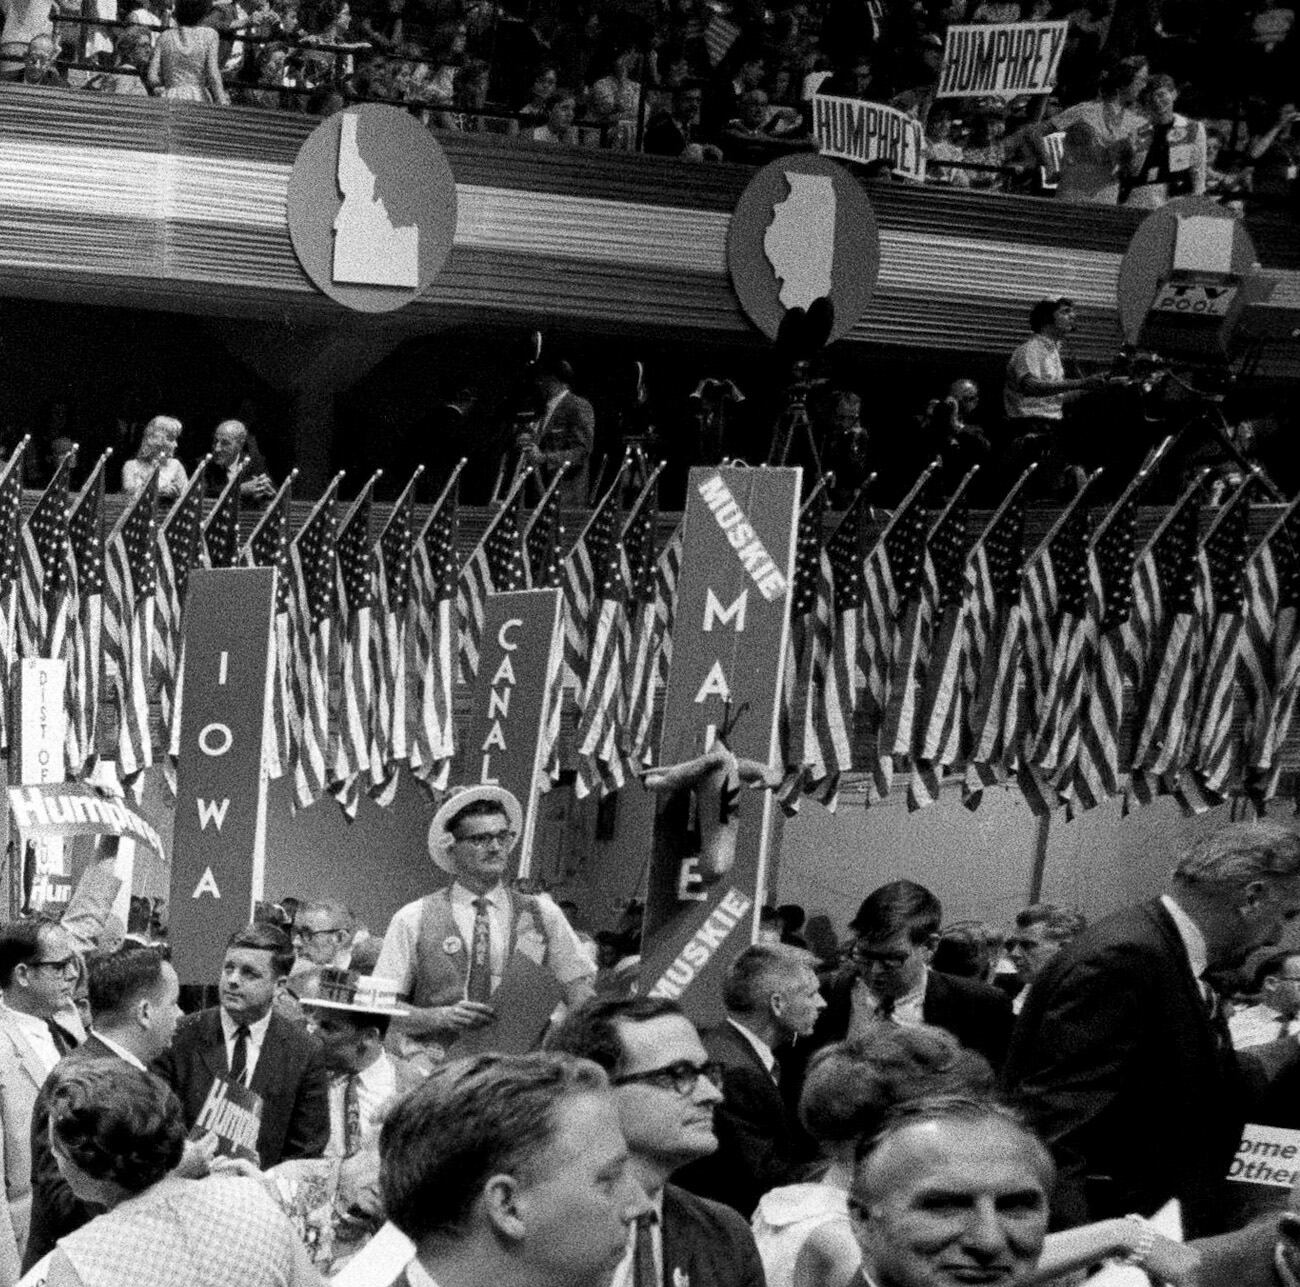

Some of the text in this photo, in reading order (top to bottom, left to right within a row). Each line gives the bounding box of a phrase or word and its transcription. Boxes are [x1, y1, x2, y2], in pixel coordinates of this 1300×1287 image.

[941, 28, 1064, 93] HUMPHREY
[818, 97, 923, 178] HUMPHREY
[698, 475, 789, 600] MUSKIE
[481, 619, 523, 785] CANAL
[676, 588, 749, 901] MAIE
[192, 650, 234, 899] IOWA
[648, 888, 750, 1000] MUSKIE
[1234, 1138, 1297, 1161] ome
